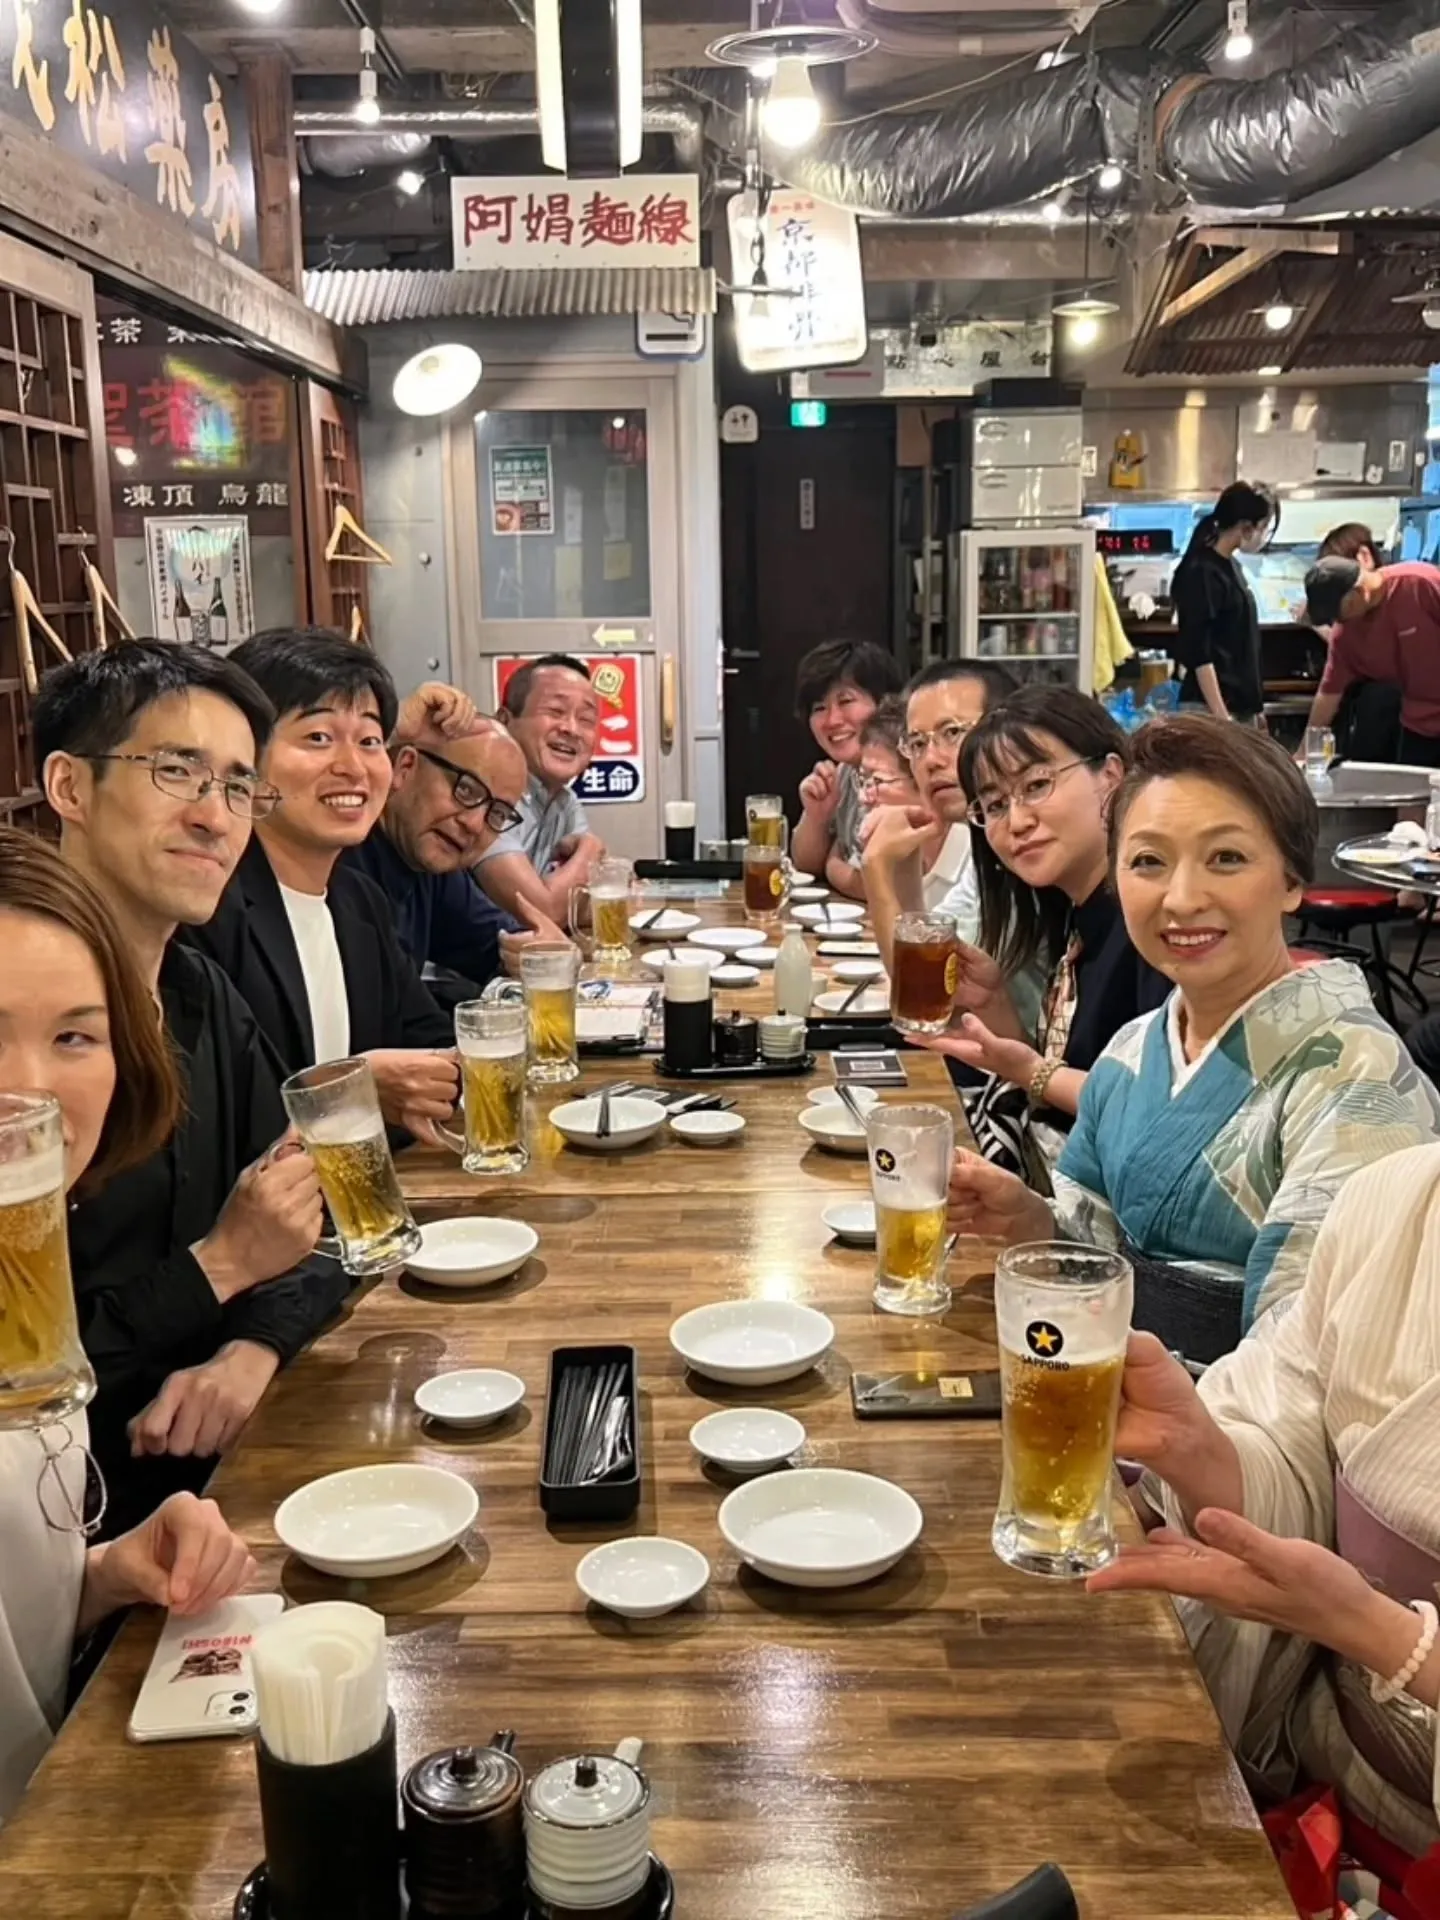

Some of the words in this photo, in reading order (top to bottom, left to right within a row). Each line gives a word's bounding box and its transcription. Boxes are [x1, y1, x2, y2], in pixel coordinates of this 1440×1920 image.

[123, 484, 194, 508] 凍頂
[581, 765, 635, 793] 生命
[1020, 1353, 1071, 1372] SAPPORO
